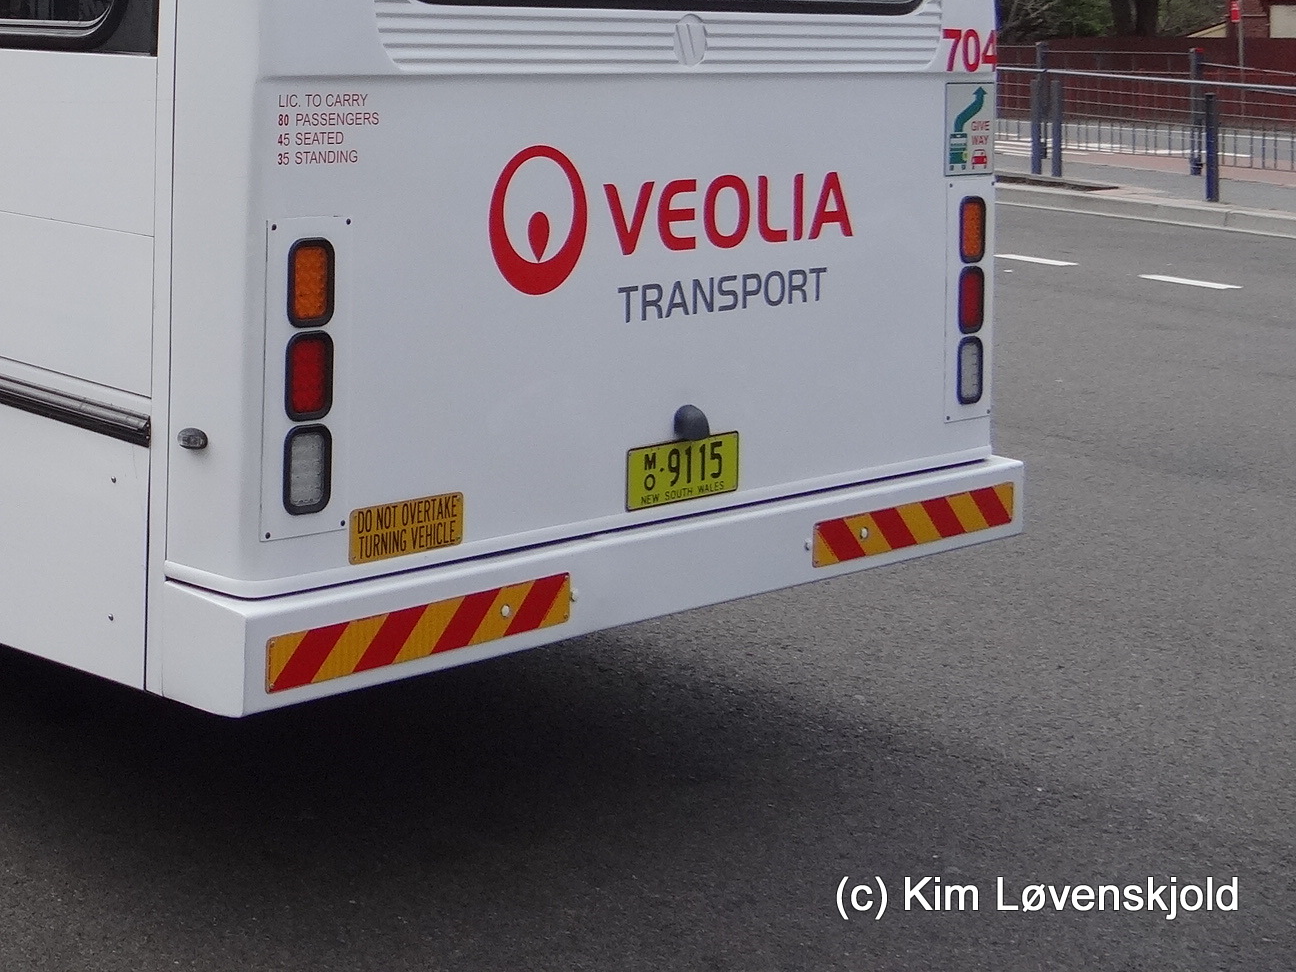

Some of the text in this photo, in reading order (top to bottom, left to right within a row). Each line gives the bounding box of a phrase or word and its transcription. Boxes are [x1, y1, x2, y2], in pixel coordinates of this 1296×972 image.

[942, 28, 998, 73] 704
[278, 93, 368, 108] LIC. TO CARRY
[278, 111, 380, 127] 80 PASSENGERS
[970, 121, 990, 131] GIVE
[277, 131, 344, 147] 45 SEATED
[971, 135, 989, 145] WAY
[277, 150, 358, 166] 35 STANDING
[603, 171, 854, 256] VEOLIA
[617, 267, 828, 324] TRANSPORT
[641, 480, 724, 505] NEW SOUTH WALES
[357, 495, 458, 534] DO NOT OVERTAKE
[358, 520, 456, 559] TURNING VEHICLE
